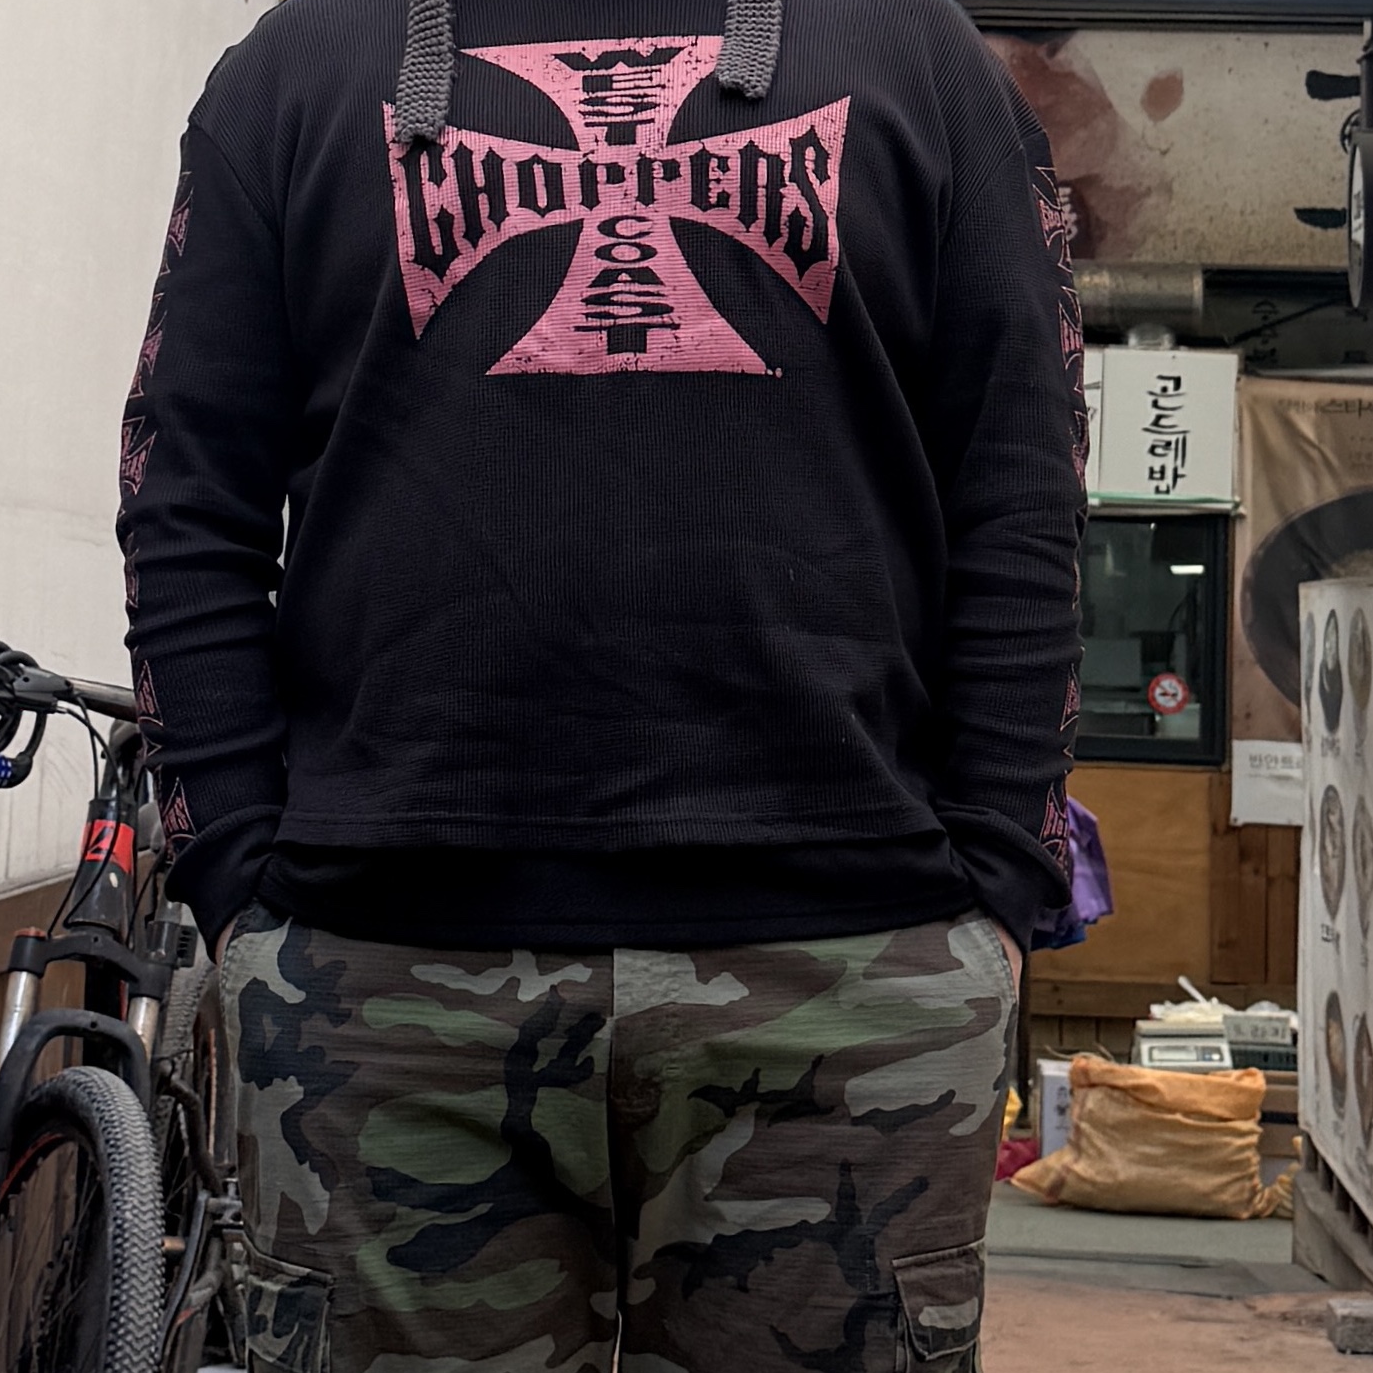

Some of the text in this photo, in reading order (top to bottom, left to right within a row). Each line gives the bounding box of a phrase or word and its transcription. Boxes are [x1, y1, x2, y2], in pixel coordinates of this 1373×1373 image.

[551, 46, 688, 146] WEST
[397, 125, 830, 283] CHOPPERS
[574, 215, 681, 355] COAST
[1141, 374, 1191, 496] 곤드레밥
